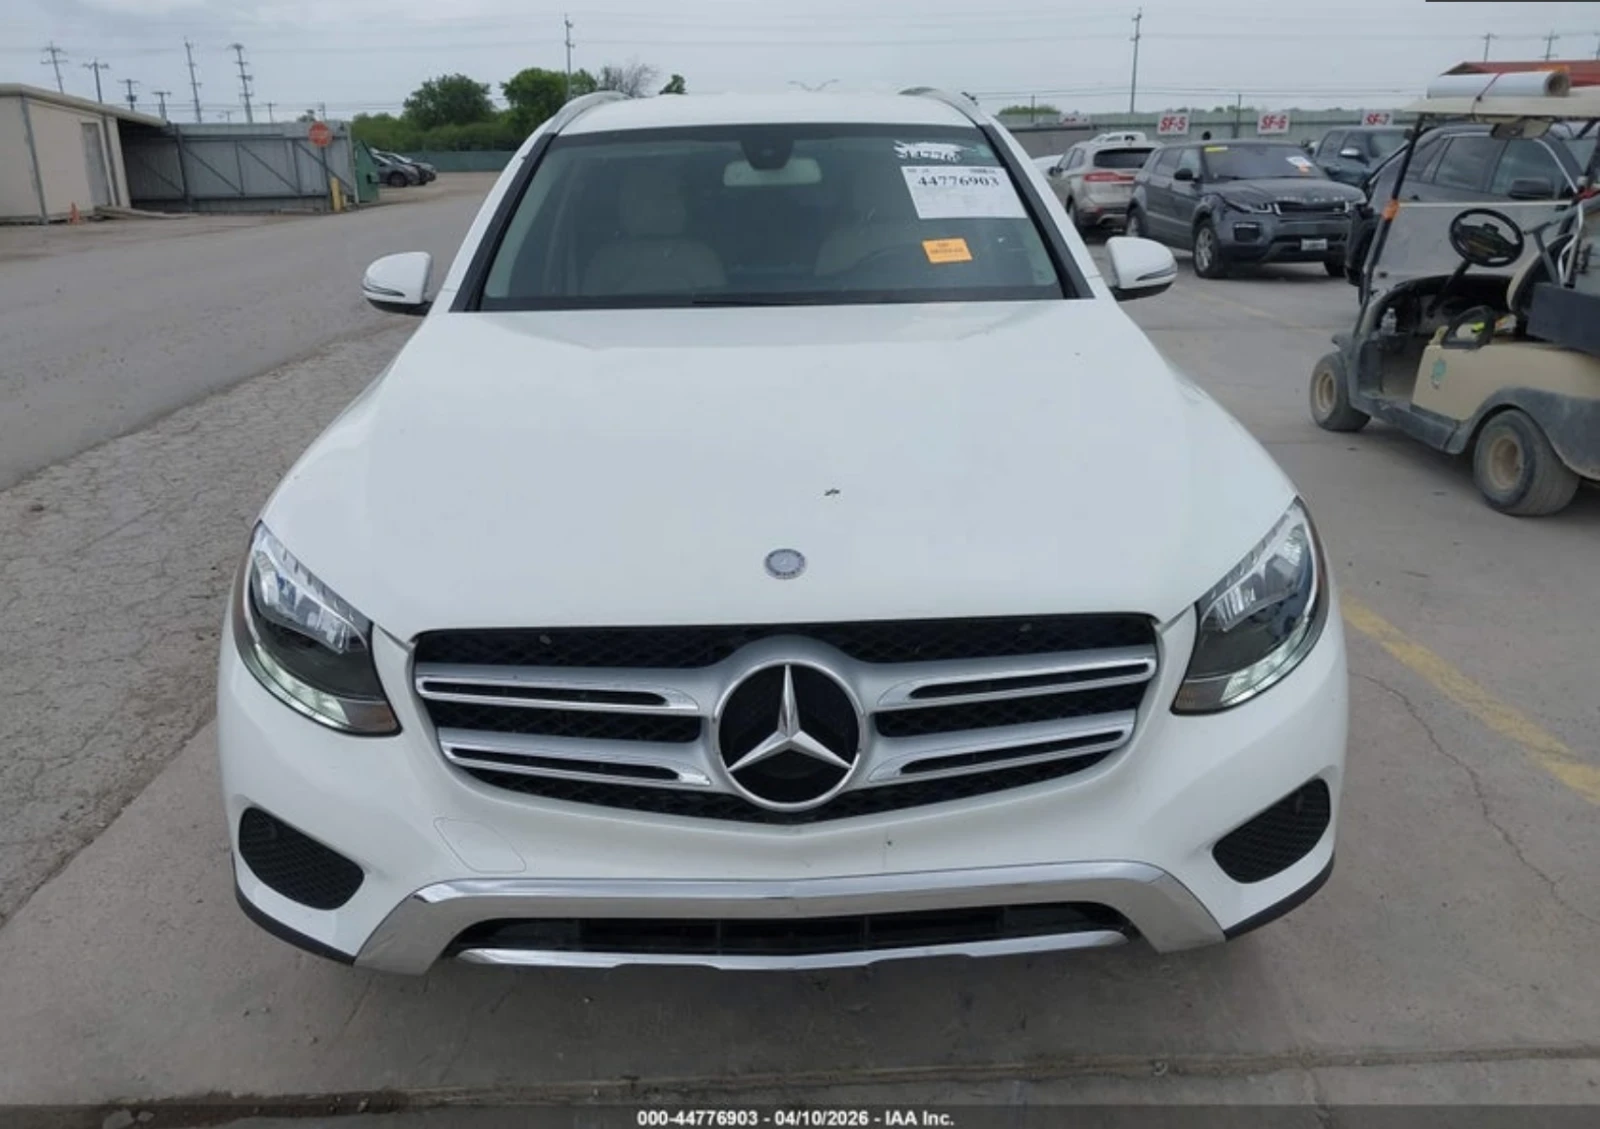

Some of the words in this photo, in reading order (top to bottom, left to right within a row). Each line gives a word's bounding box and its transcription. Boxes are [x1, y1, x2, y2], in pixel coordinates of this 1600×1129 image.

[1160, 115, 1186, 132] SF-5
[1261, 114, 1287, 130] SF-6
[917, 175, 1000, 187] 44776903
